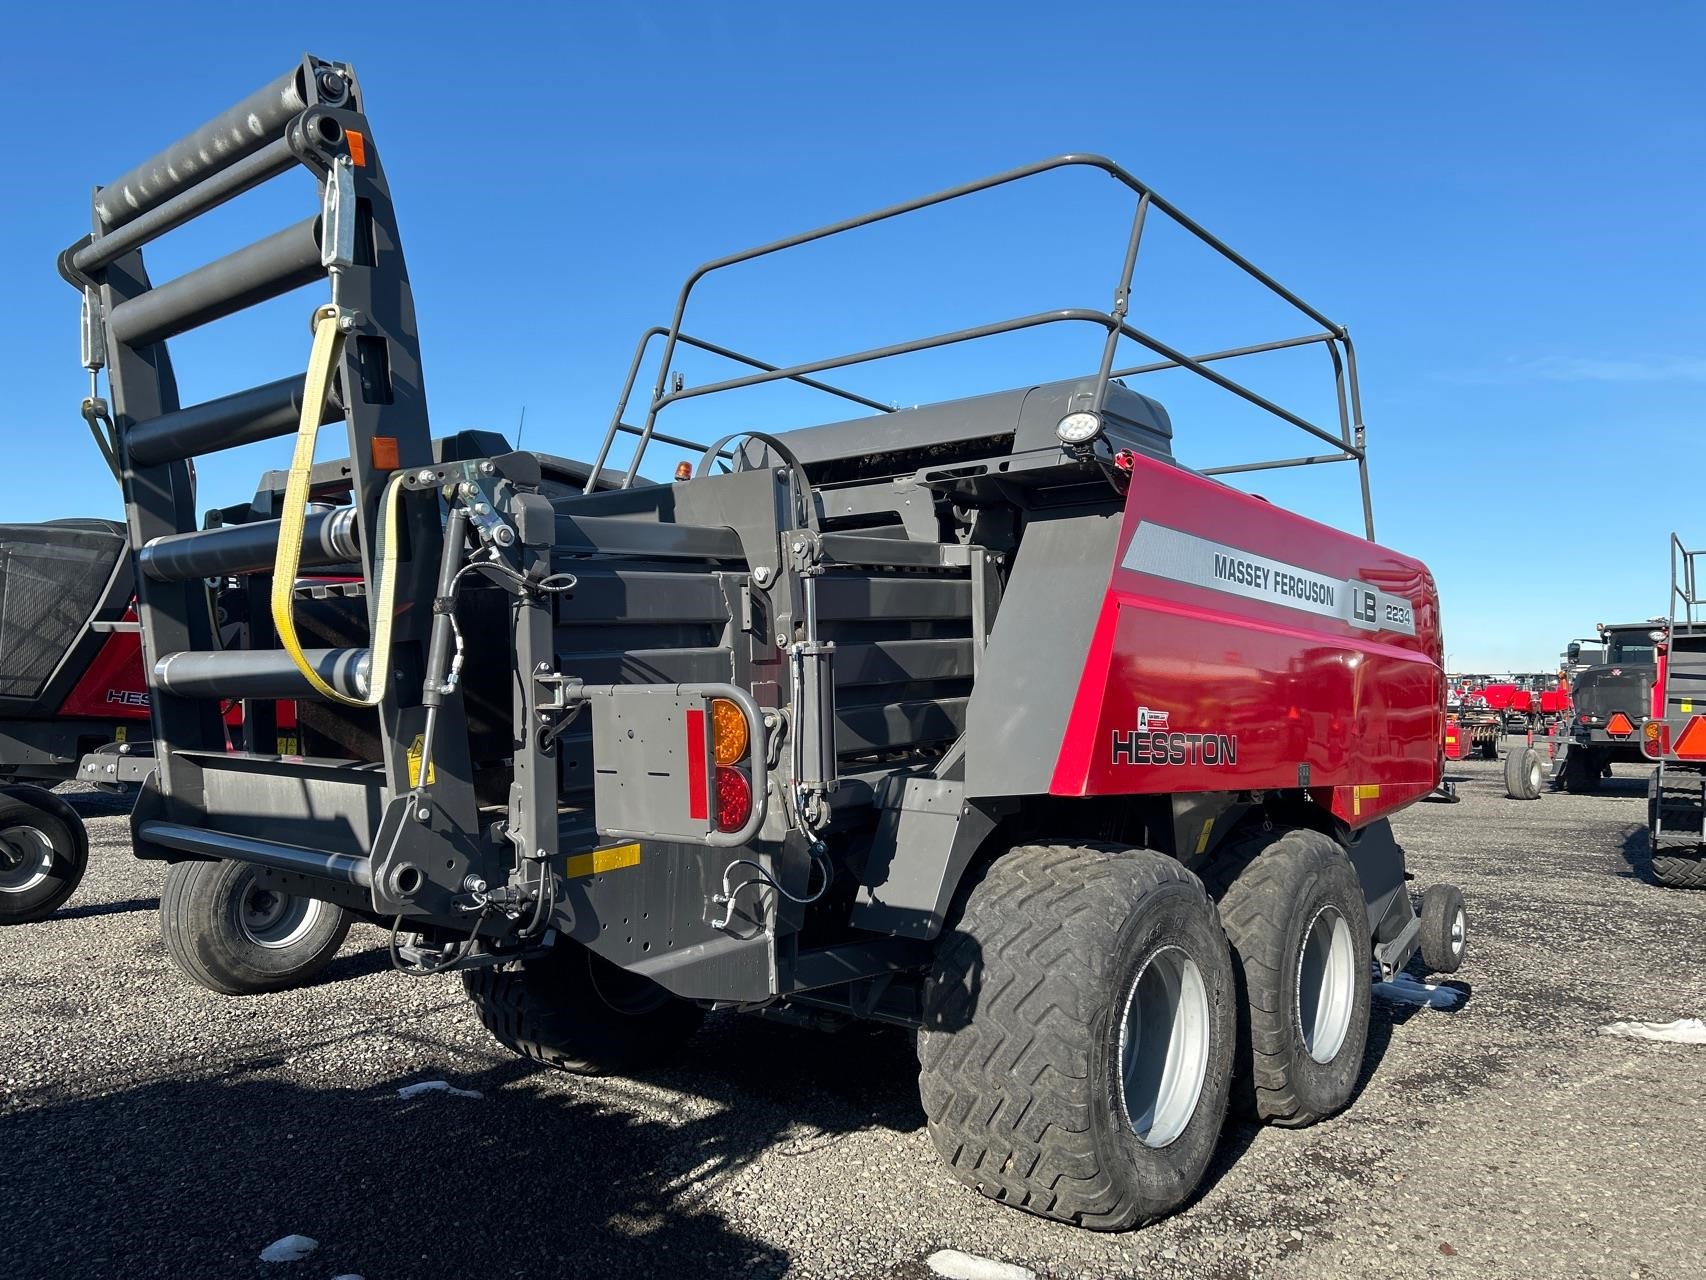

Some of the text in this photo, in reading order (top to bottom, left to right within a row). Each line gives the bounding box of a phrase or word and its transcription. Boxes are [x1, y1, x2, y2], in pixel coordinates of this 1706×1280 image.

[1213, 553, 1335, 607] MASSEY FERGUSON
[1352, 587, 1411, 625] LB 2234
[1111, 729, 1238, 766] HESSTON
